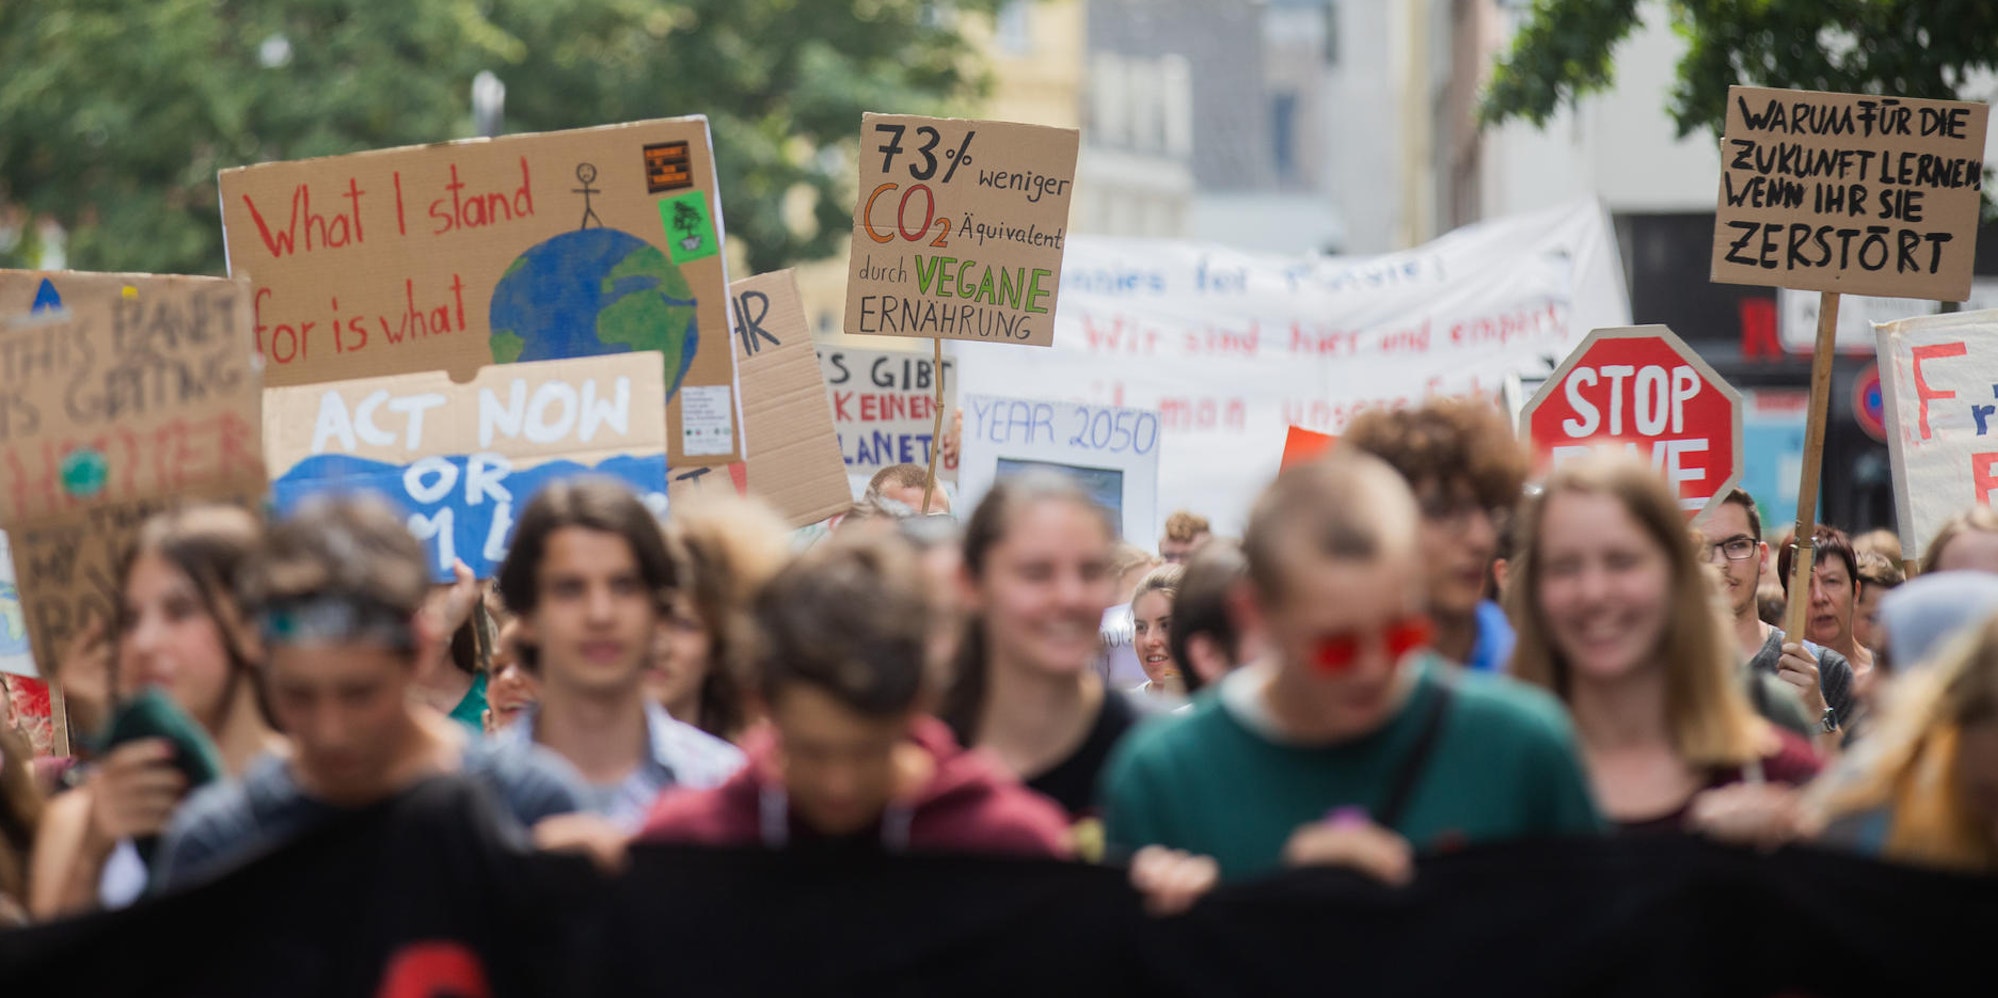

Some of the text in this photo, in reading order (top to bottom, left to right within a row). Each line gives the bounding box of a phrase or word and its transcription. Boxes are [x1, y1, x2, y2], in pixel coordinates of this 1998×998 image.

[1738, 96, 1855, 136] WARUM
[1918, 107, 1971, 139] DIE
[875, 124, 1070, 203] 73% weniger
[1730, 139, 1876, 181] ZUKUNFT
[243, 156, 534, 258] What I stand
[1725, 171, 1925, 222] WENN IHR SIE
[958, 212, 1064, 249] Äquivalent
[859, 255, 1052, 314] durch VEGANE
[254, 273, 467, 364] for is what
[860, 296, 1031, 340] ERNÄHRUNG
[817, 352, 952, 391] S GIBT
[311, 388, 447, 454] ACT
[478, 375, 631, 449] NOW
[834, 390, 940, 422] KEINEN
[971, 400, 1157, 456] YEAR 2050
[1562, 365, 1702, 438] STOP
[403, 452, 513, 507] OR
